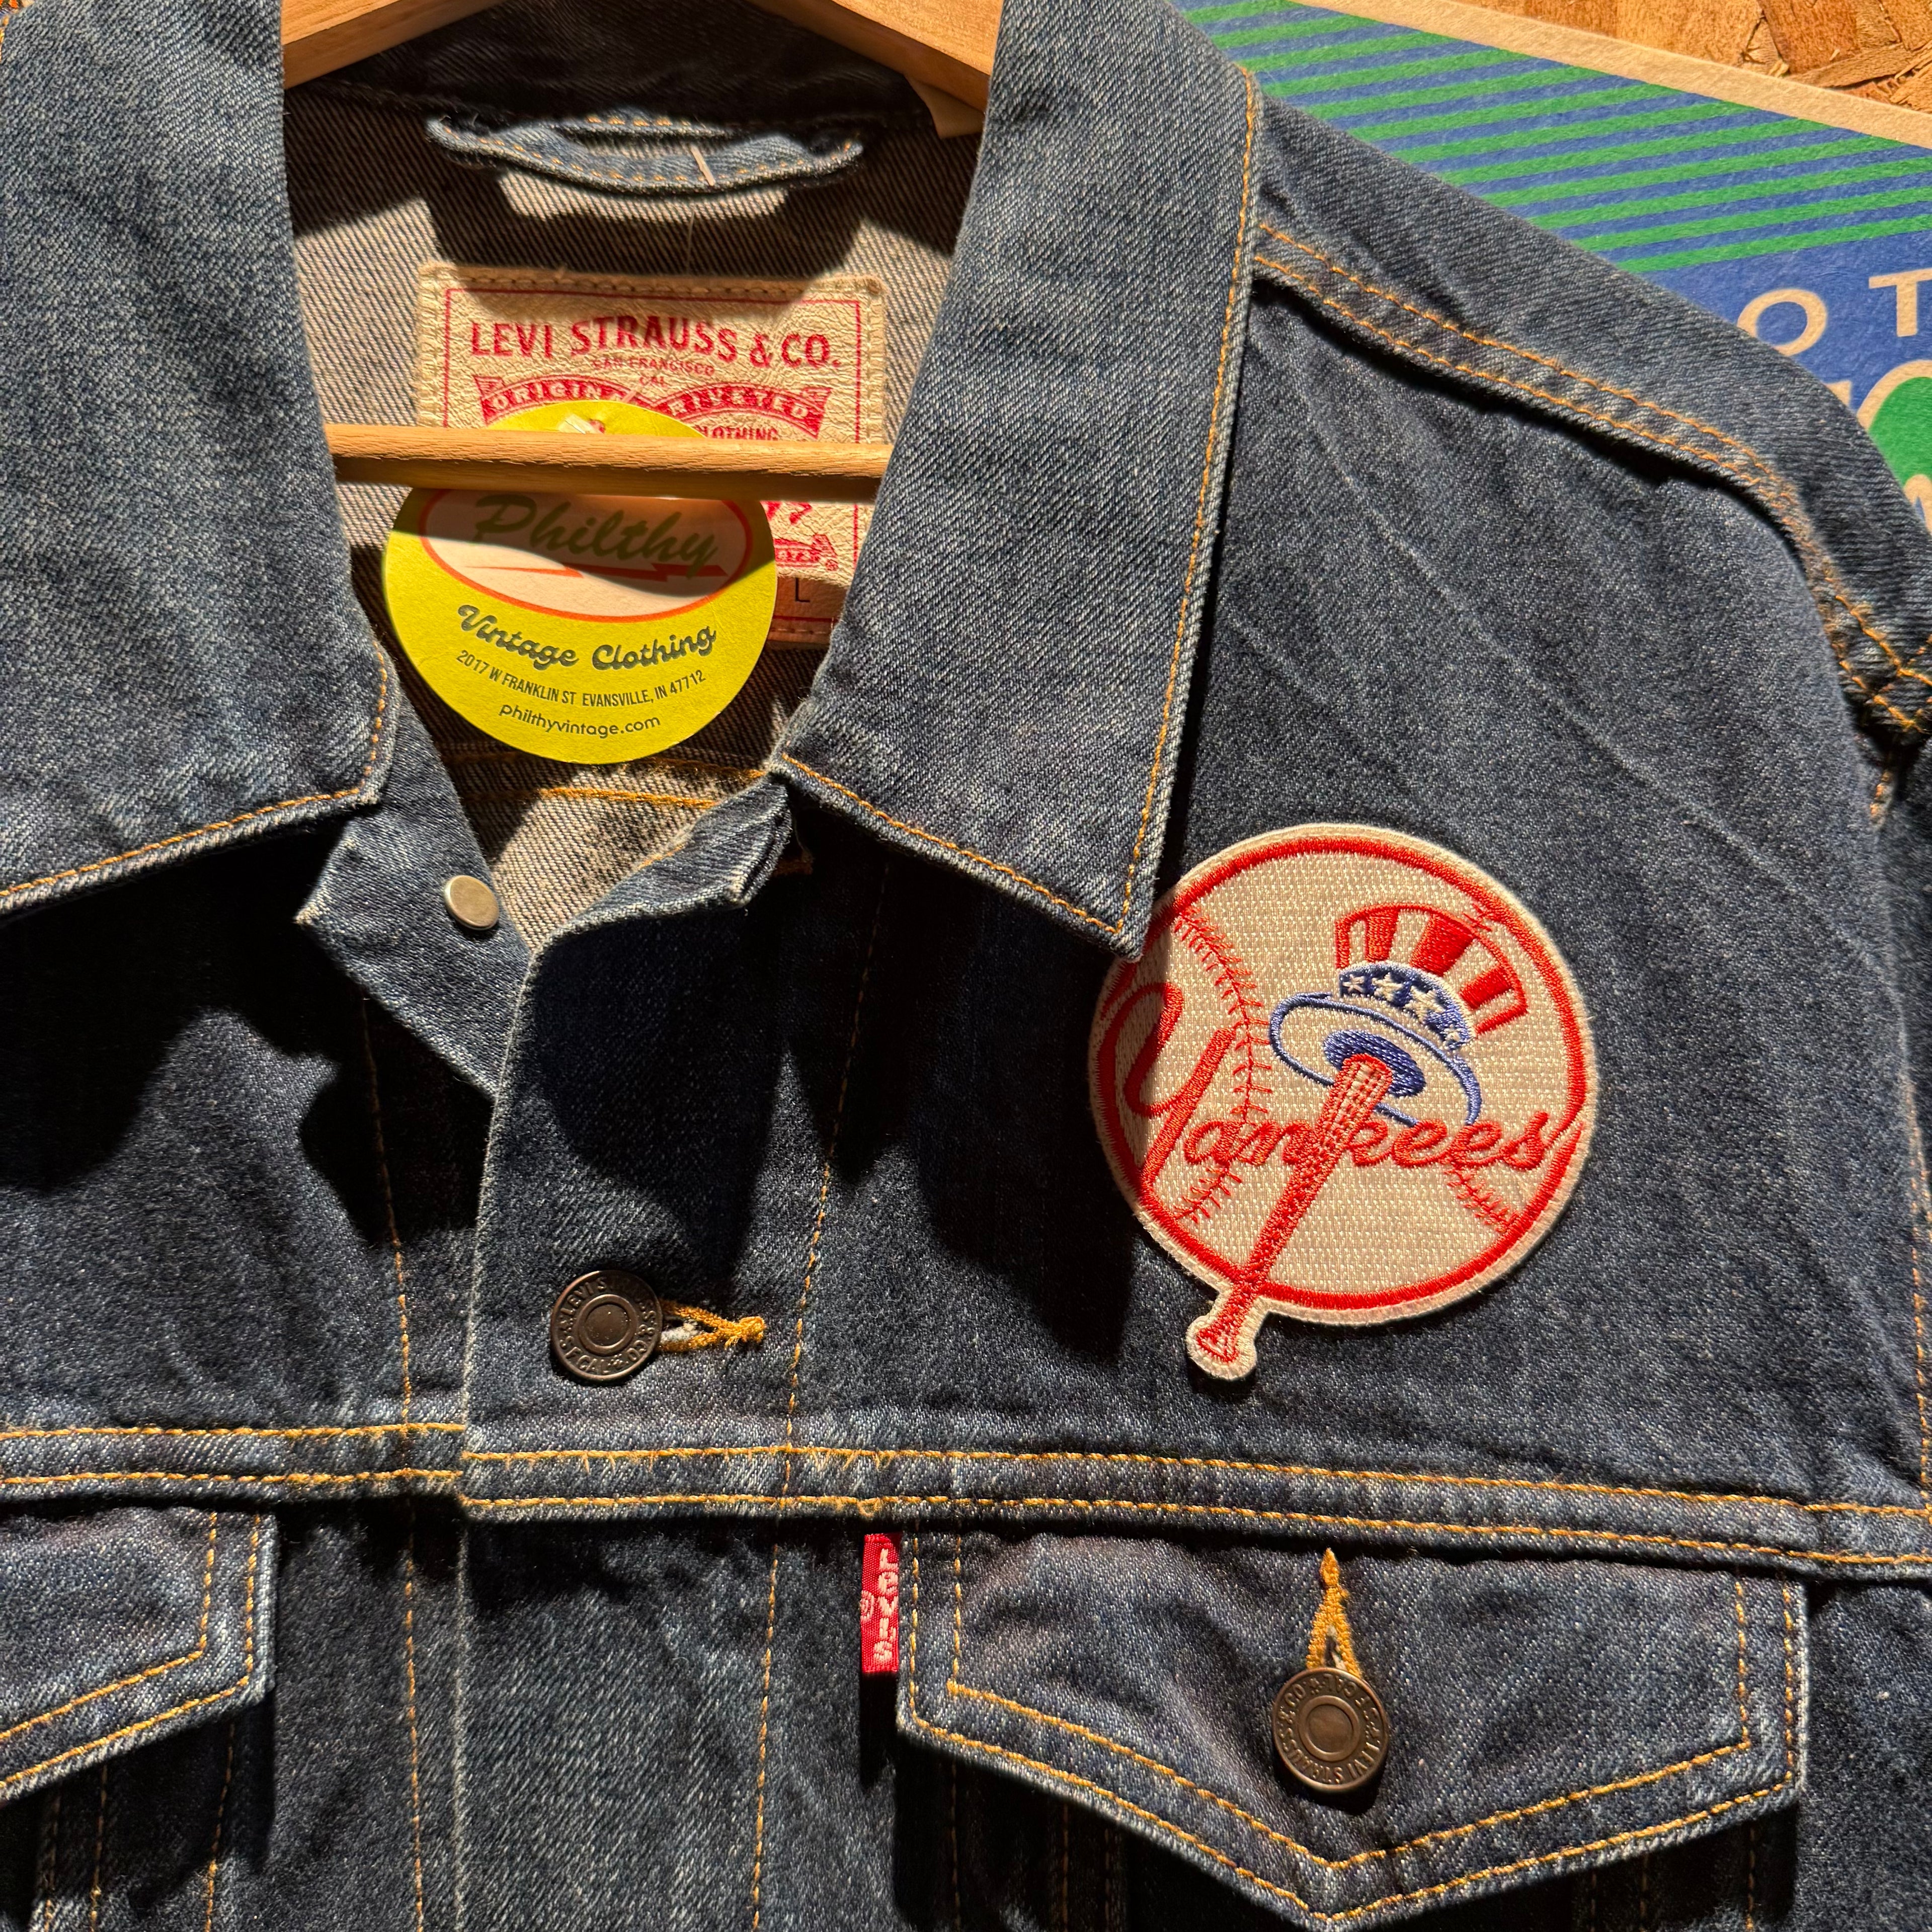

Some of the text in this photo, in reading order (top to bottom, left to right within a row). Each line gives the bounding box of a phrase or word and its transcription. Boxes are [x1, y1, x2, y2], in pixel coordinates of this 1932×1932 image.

[471, 315, 841, 368] LEVI STRAUSS & CO.
[628, 357, 715, 376] FRANCISCO
[669, 386, 810, 420] RIVETED
[474, 494, 717, 578] Philthy
[795, 578, 811, 603] L
[457, 605, 717, 670] Vintage Clothing
[456, 649, 706, 707] 2017 W FRANKLIN ST EVANSVILLE, IN 47712
[499, 704, 661, 740] philthyvintage.com
[1119, 981, 1552, 1193] Yankees
